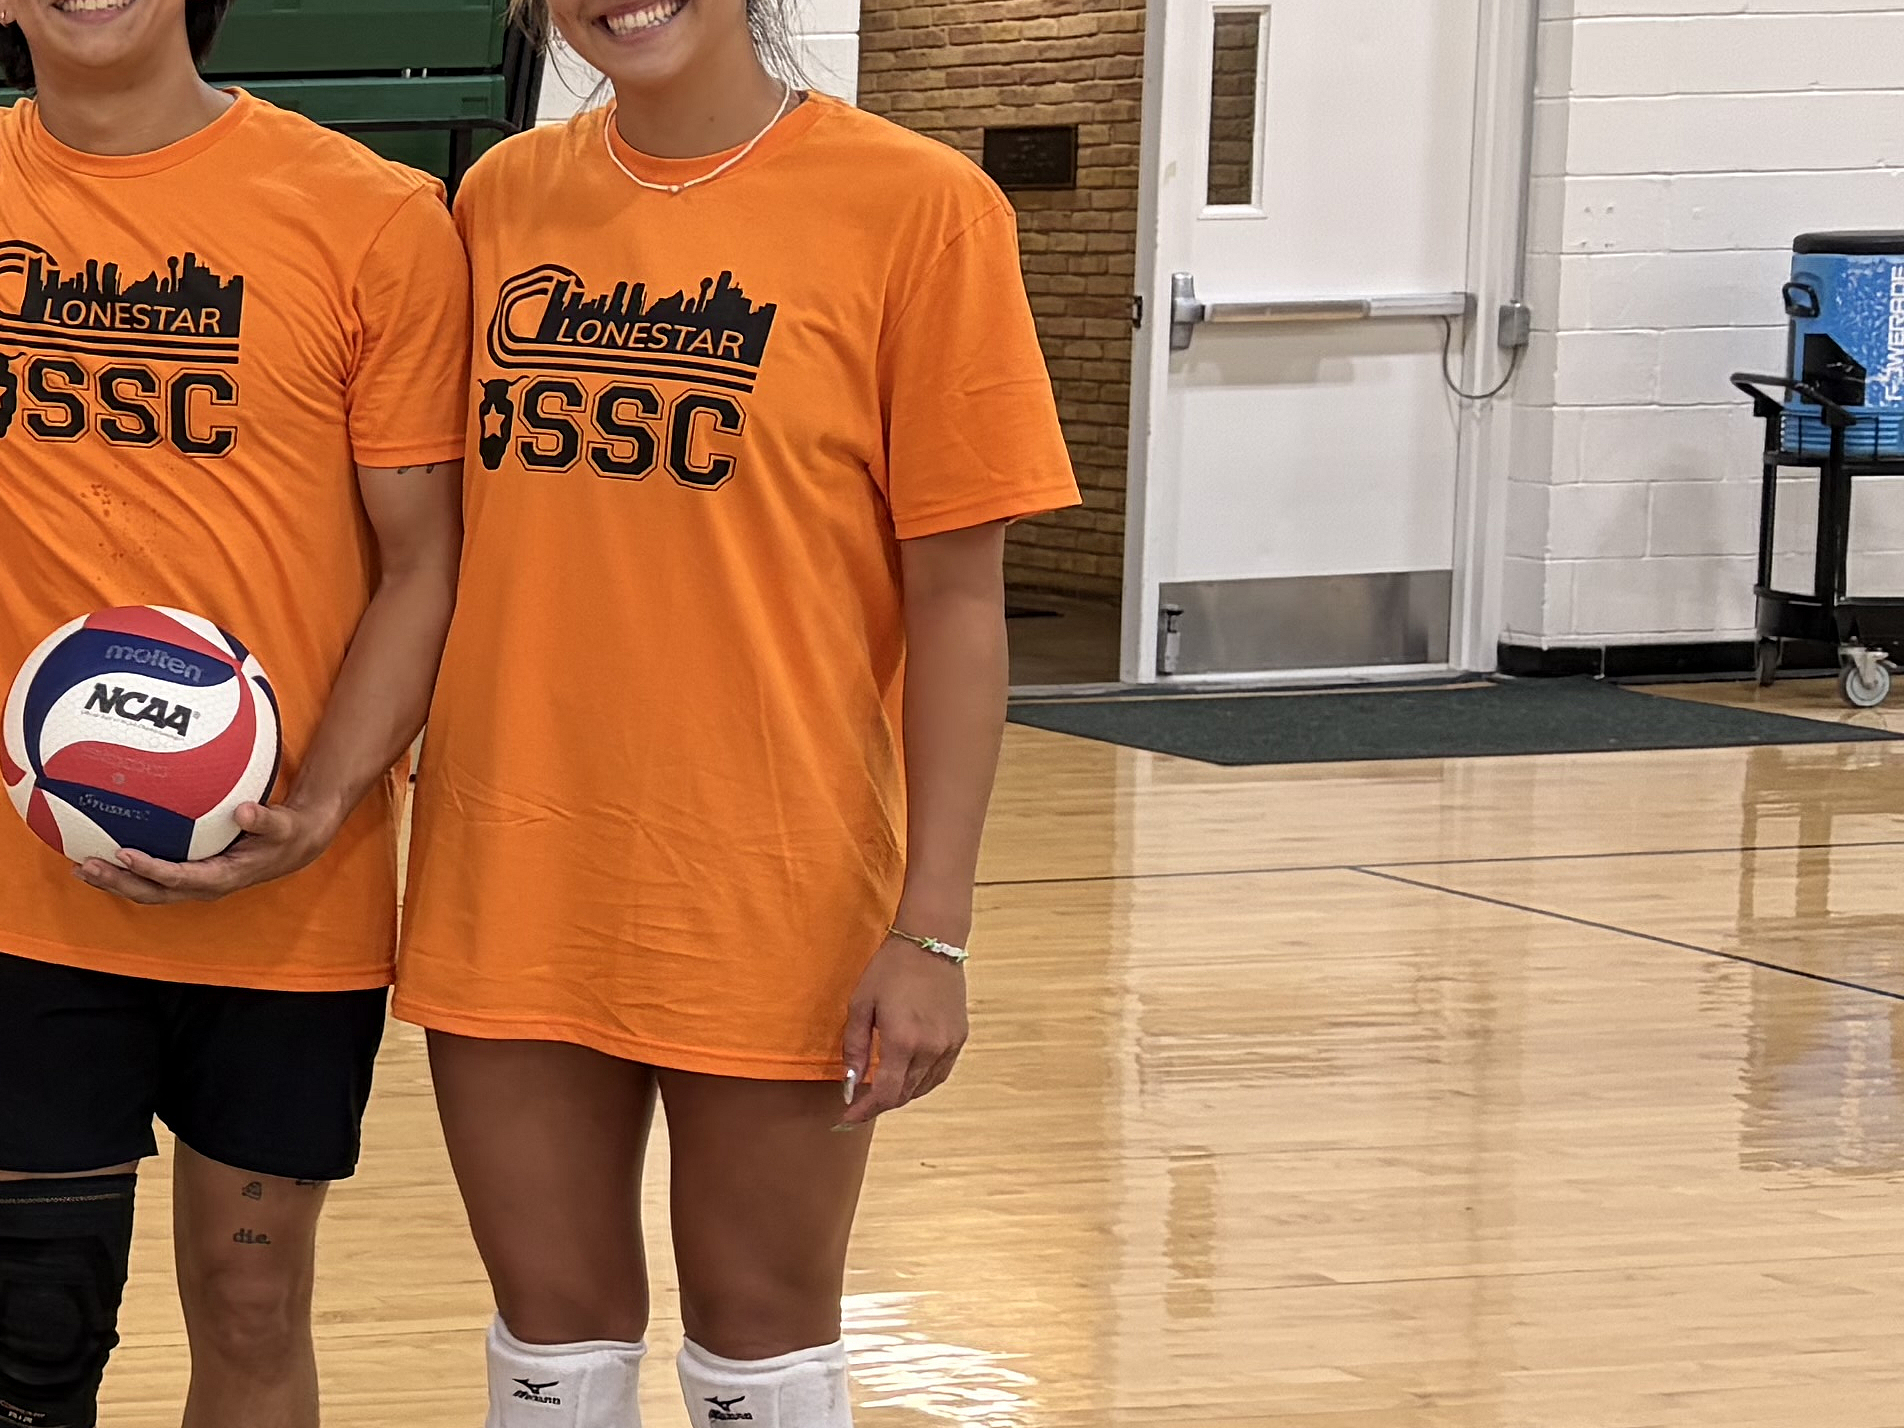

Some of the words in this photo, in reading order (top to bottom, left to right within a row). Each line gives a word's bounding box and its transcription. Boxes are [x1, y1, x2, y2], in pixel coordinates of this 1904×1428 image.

[43, 299, 221, 335] LONESTAR
[556, 320, 744, 358] LONESTAR
[23, 355, 239, 458] SSC
[516, 376, 746, 491] SSC
[105, 644, 205, 684] molten
[84, 683, 193, 738] NCAA
